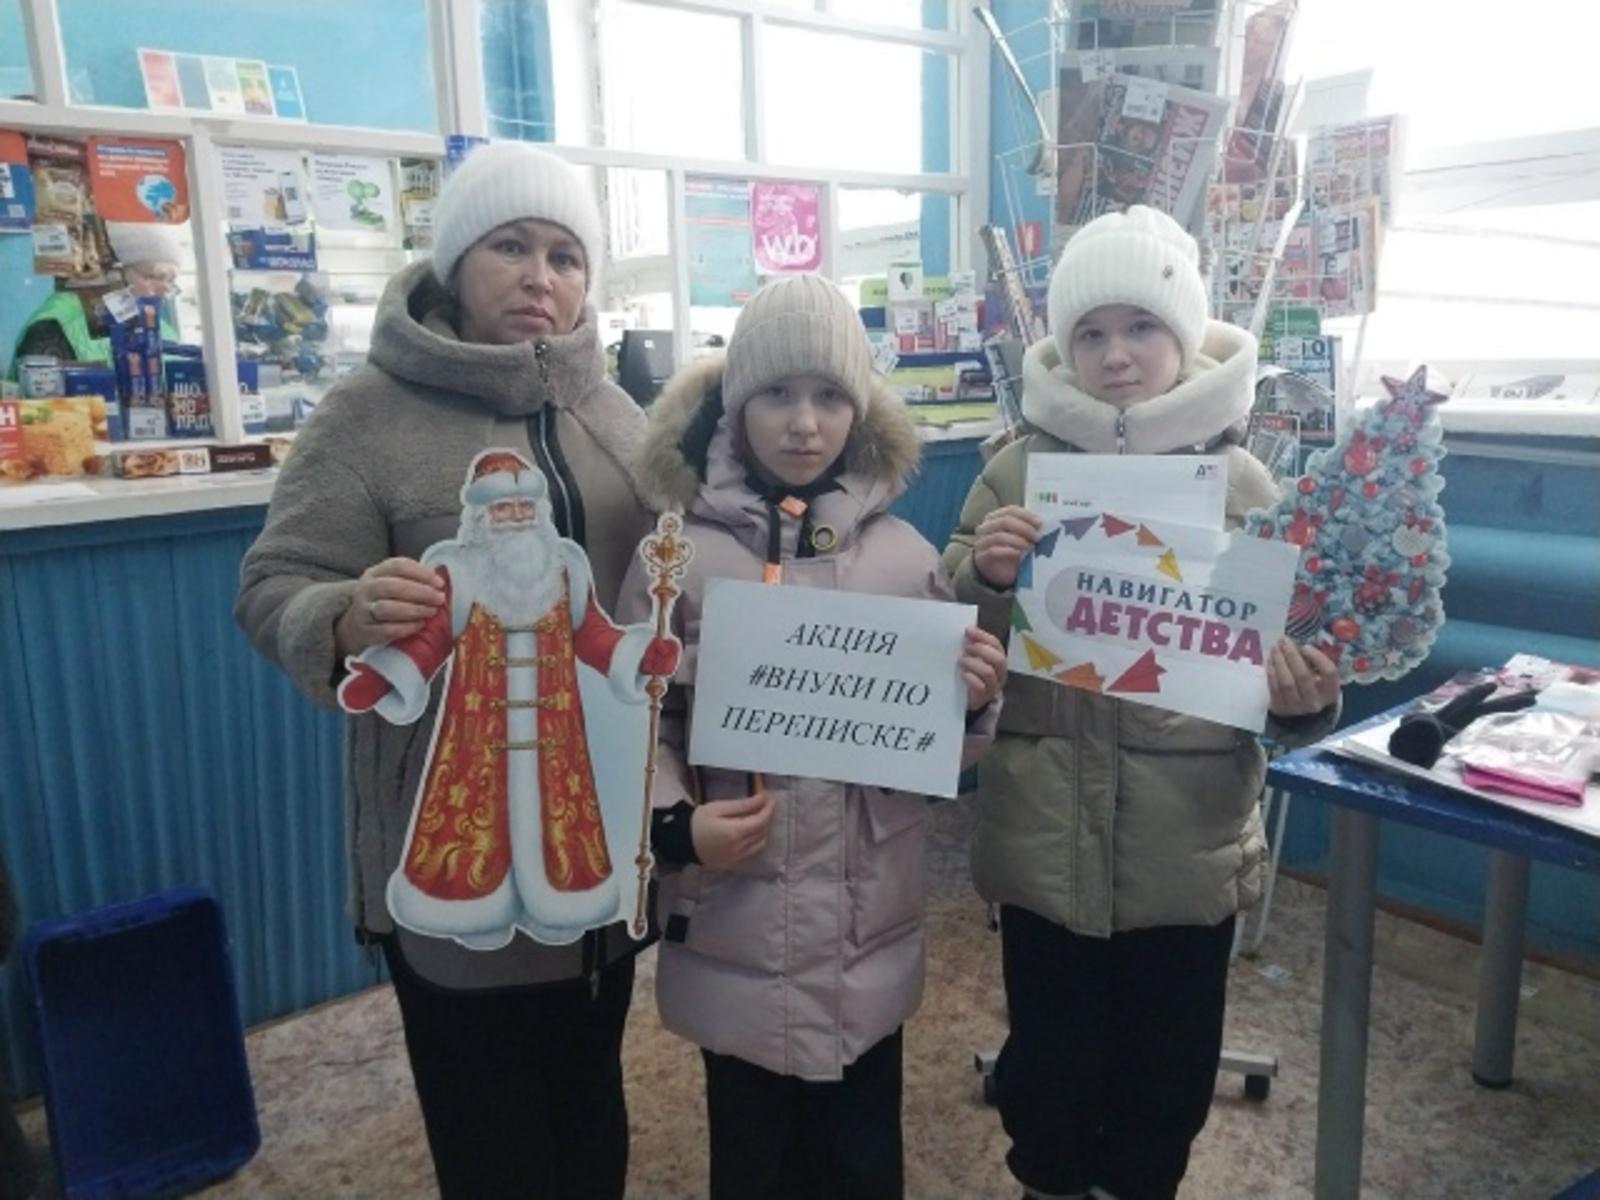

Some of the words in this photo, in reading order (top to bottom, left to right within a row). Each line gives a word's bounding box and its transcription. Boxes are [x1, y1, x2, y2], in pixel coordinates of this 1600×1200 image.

[1076, 571, 1258, 621] НАВИГАТОР
[785, 622, 899, 656] АКЦИЯ
[1066, 596, 1264, 666] ДЕТСТВА
[748, 663, 876, 701] #ВНУКИ
[881, 679, 931, 707] ПО
[720, 704, 936, 753] ПЕРЕПИСКЕ#
